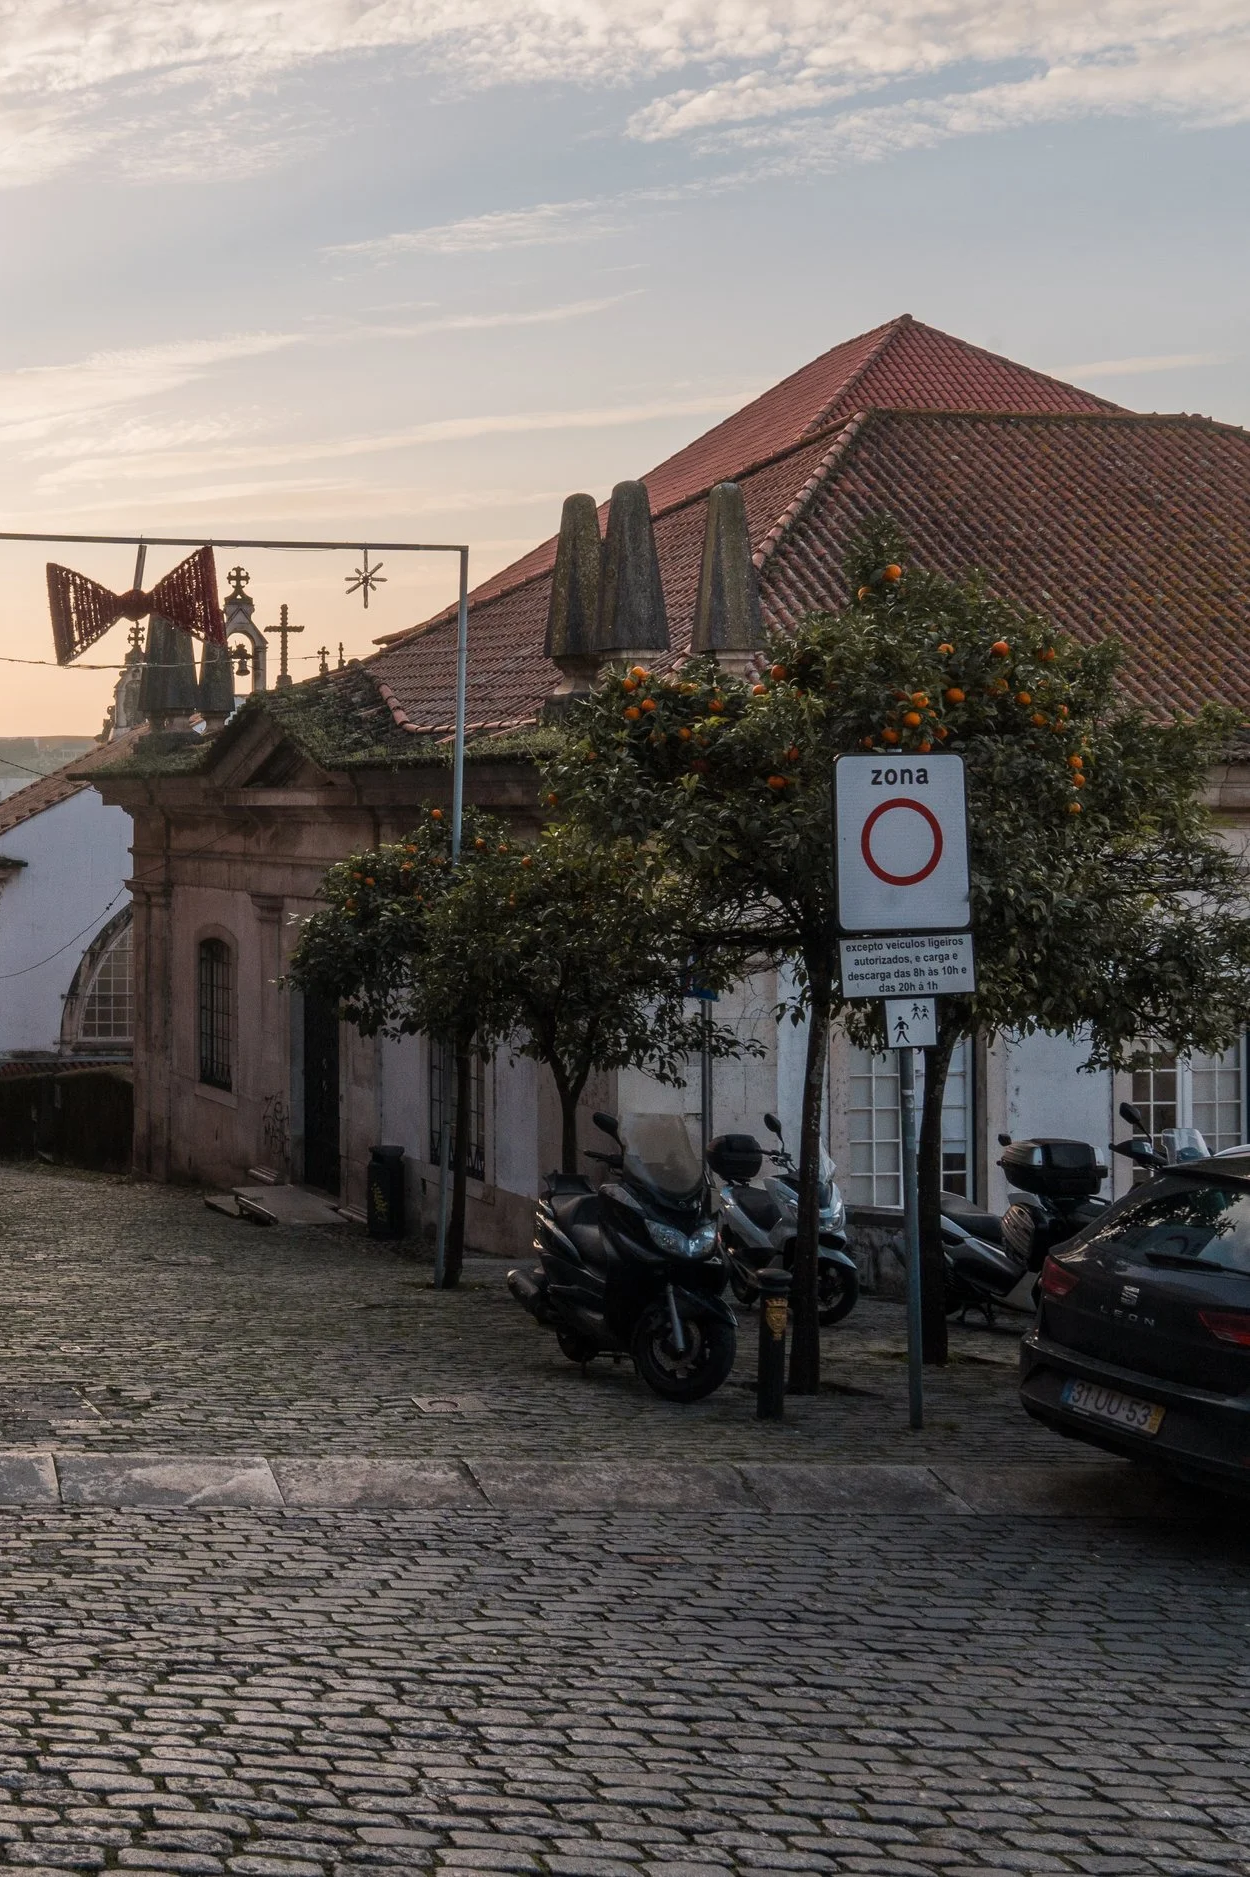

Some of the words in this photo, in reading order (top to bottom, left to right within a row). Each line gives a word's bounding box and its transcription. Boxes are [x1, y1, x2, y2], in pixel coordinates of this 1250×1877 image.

[871, 768, 929, 785] zona
[846, 942, 883, 953] excepto
[928, 937, 964, 949] ligeiros
[854, 955, 913, 966] autorizados,
[923, 953, 950, 963] carga
[952, 952, 958, 960] e
[847, 970, 891, 981] descarga
[894, 969, 911, 978] das
[913, 967, 925, 977] 8h
[942, 965, 958, 975] 10h
[961, 966, 967, 974] e
[879, 983, 895, 993] das
[898, 982, 915, 992] 20h
[927, 981, 938, 990] 1h
[1100, 1304, 1155, 1326] LEON
